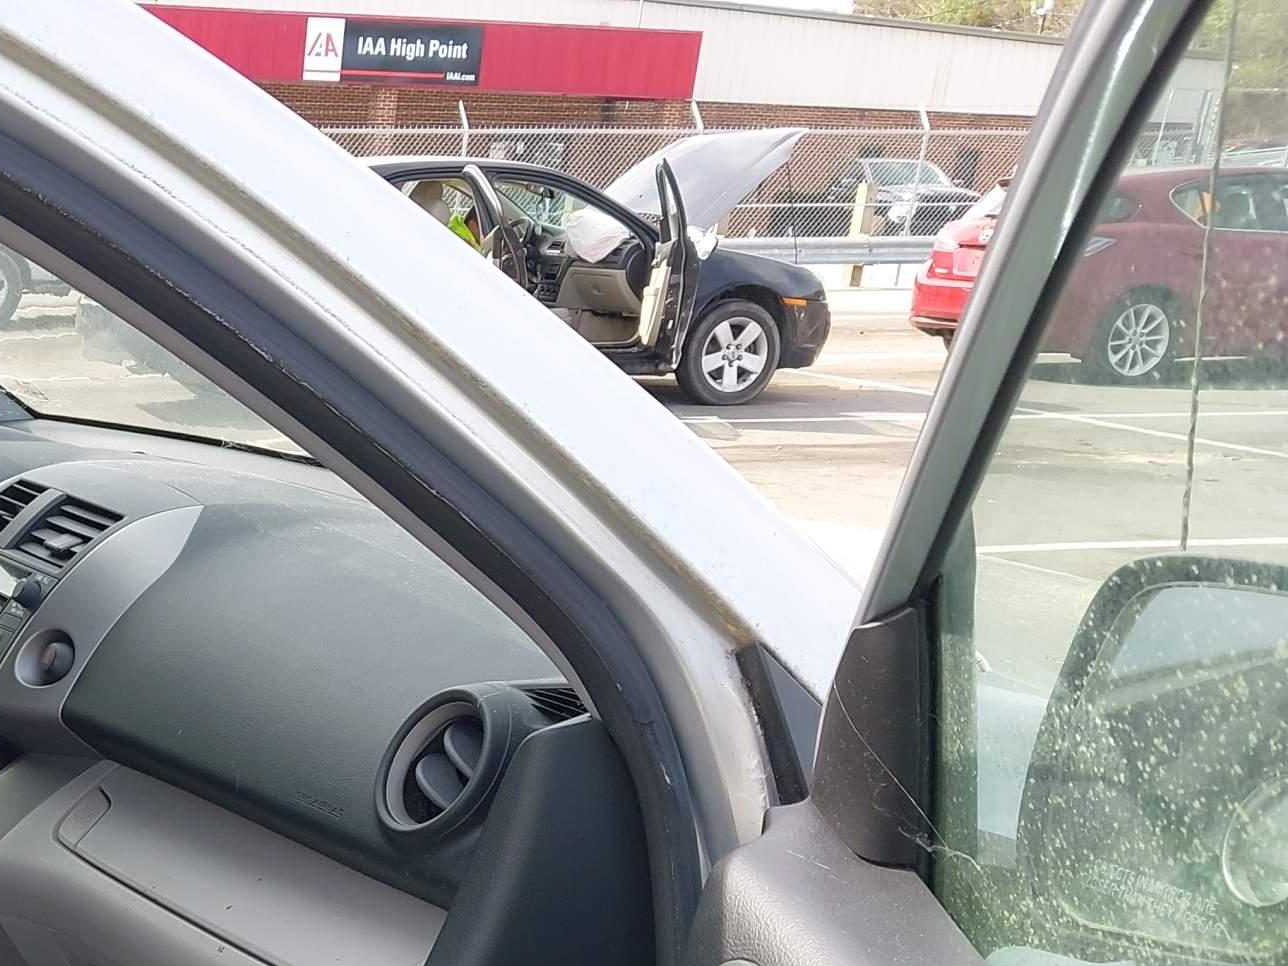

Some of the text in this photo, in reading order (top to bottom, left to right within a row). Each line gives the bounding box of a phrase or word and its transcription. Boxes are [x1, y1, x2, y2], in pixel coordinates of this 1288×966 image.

[357, 36, 468, 60] IAA High Point
